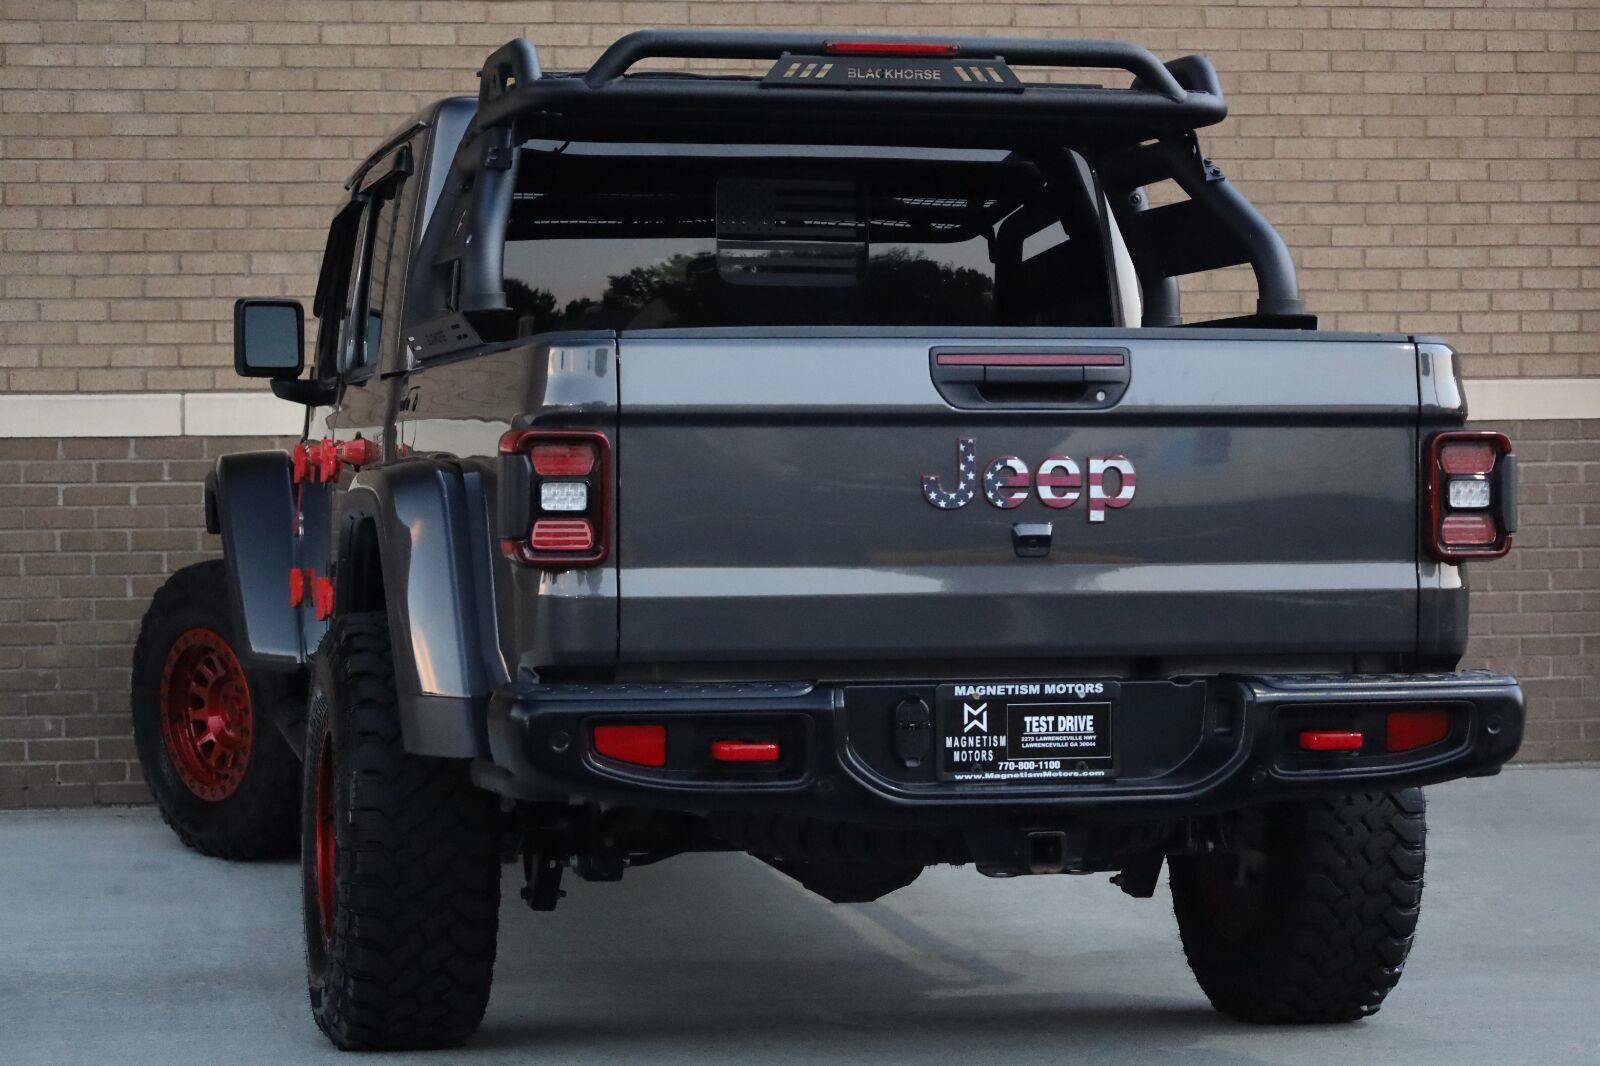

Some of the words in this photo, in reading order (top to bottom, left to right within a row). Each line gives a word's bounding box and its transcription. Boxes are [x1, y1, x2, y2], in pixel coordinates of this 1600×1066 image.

[848, 67, 941, 80] BLACKHORSE
[921, 435, 1137, 523] Jeep
[954, 684, 1041, 697] MAGNETISM
[1044, 683, 1104, 695] MOTORS
[1023, 716, 1055, 733] TEST
[1057, 715, 1094, 732] DRIVE
[945, 735, 1007, 748] MAGNETISM
[953, 750, 994, 762] MOTORS
[997, 761, 1061, 771] 770-800-1100
[954, 771, 1105, 780] www.MagnetismMotors.com
